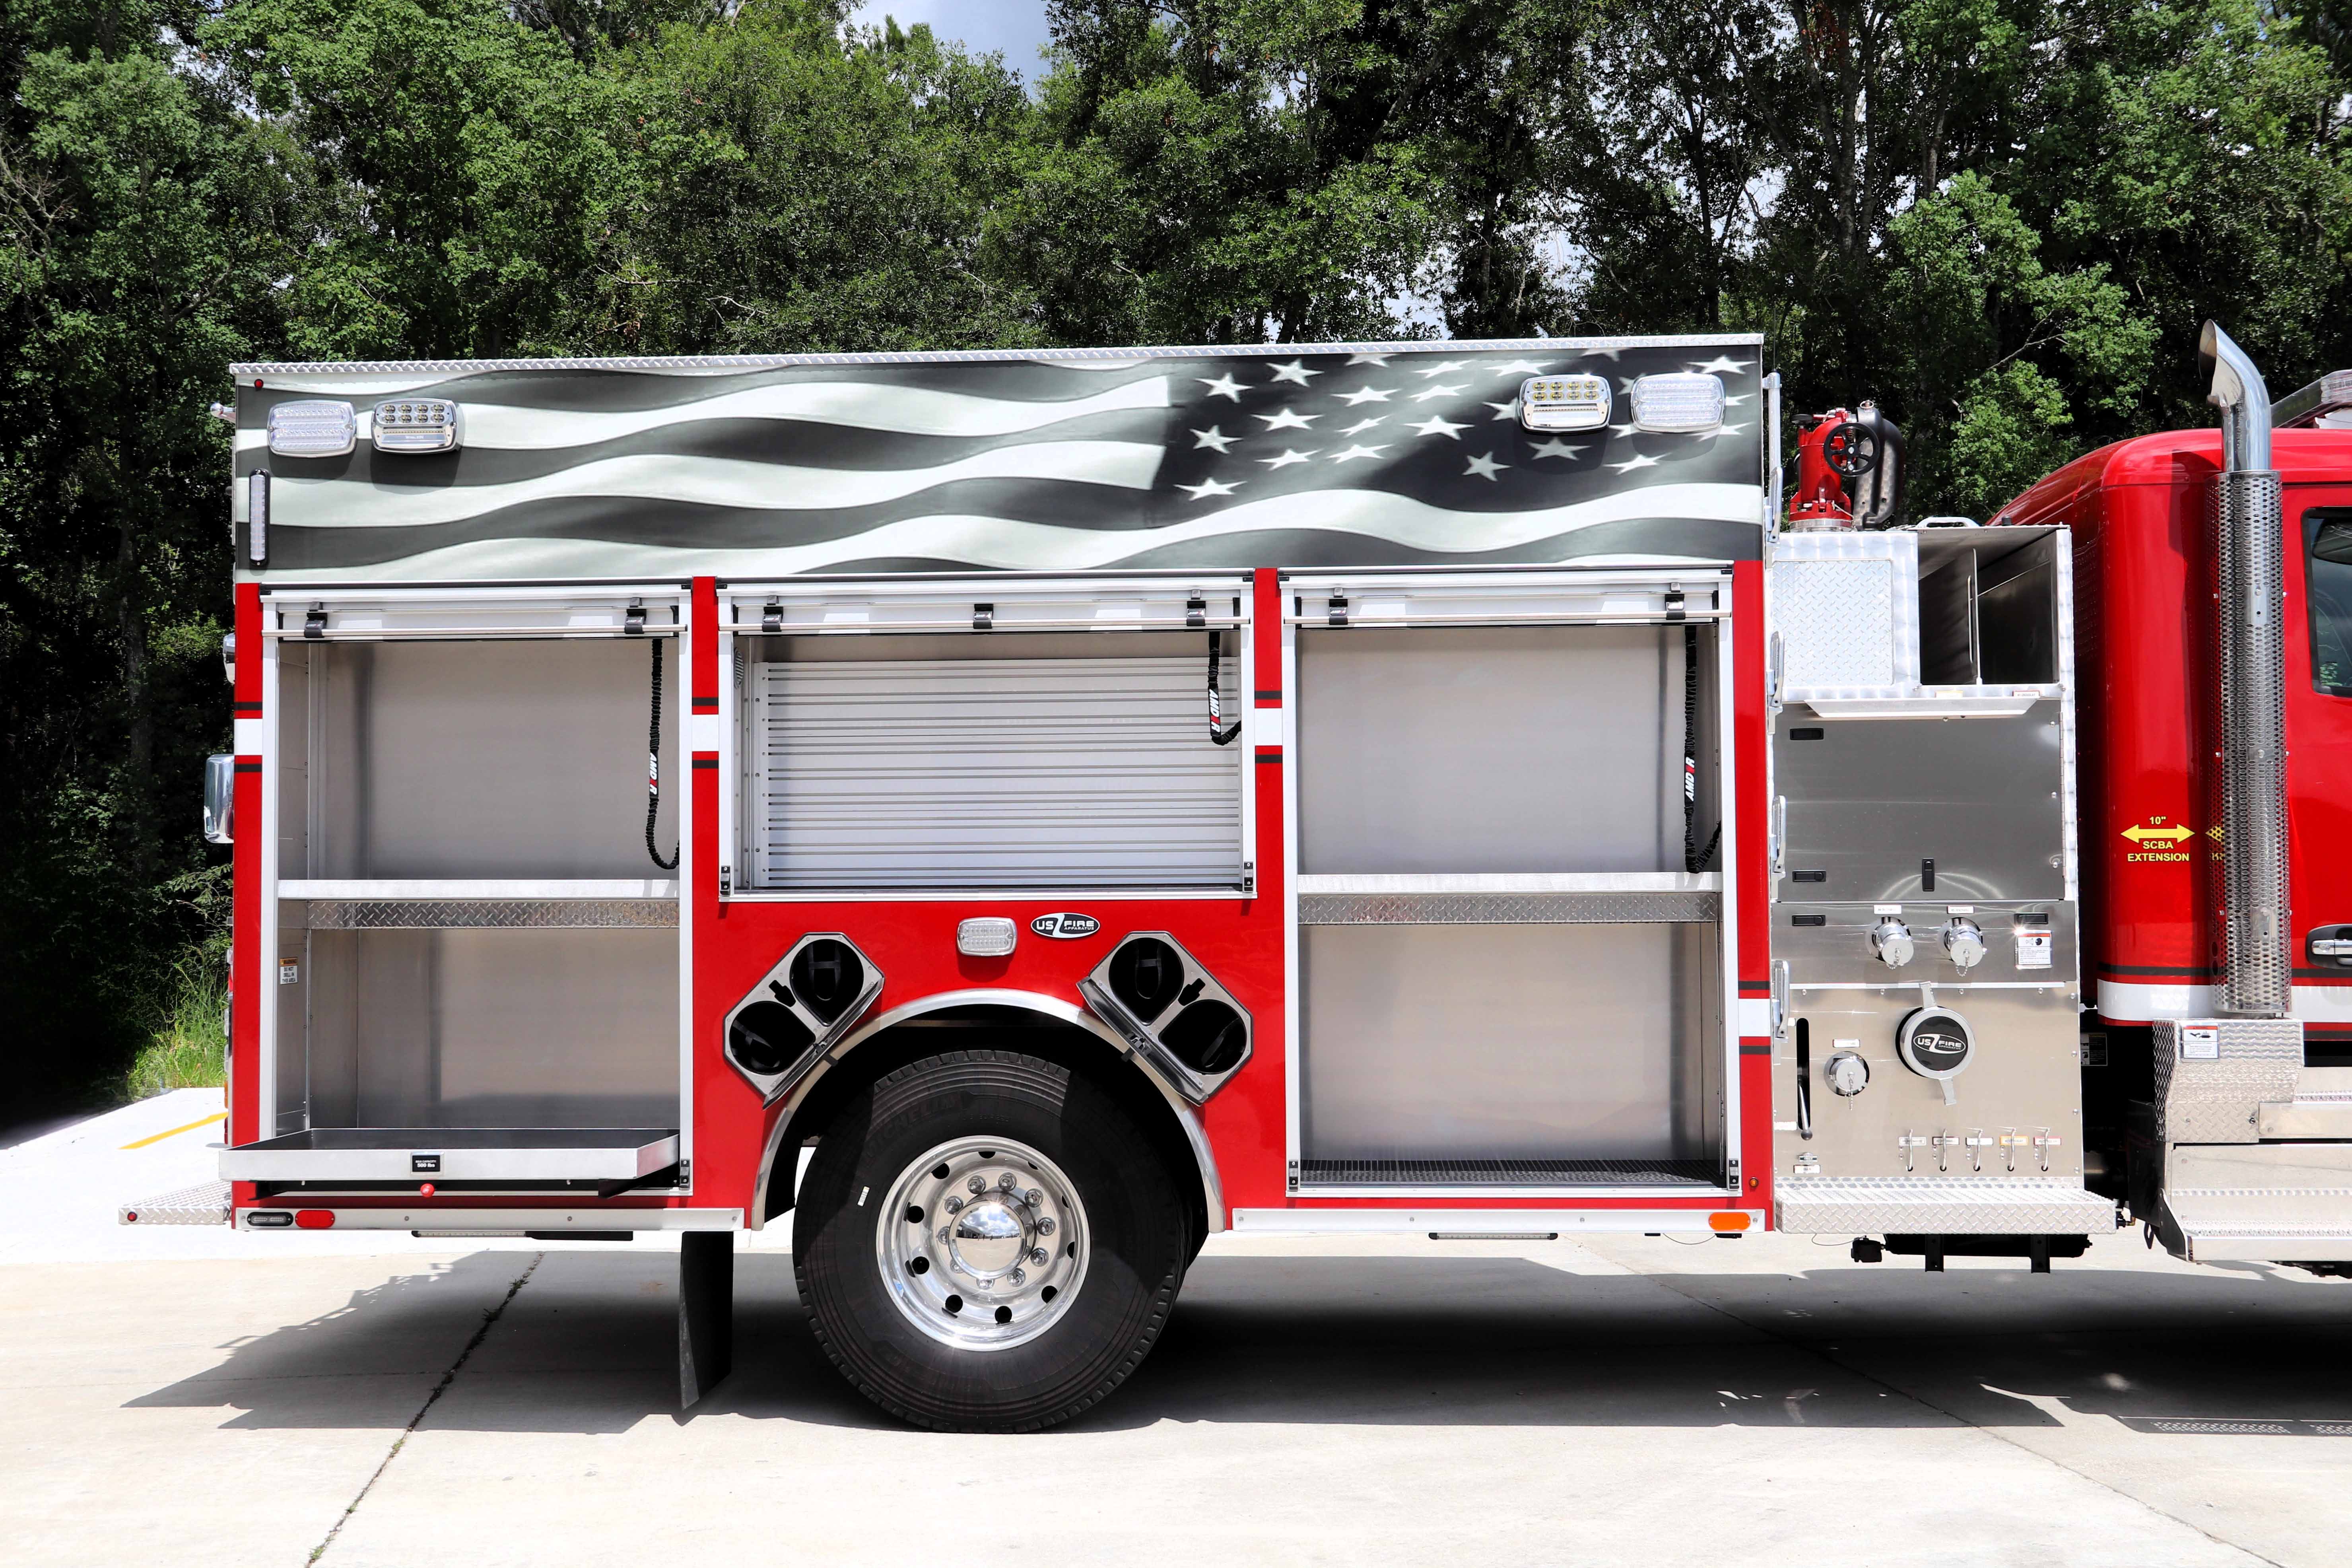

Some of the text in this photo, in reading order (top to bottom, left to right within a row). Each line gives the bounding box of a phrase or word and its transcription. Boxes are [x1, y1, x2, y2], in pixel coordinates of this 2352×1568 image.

[2142, 841, 2174, 849] SCBA
[2127, 853, 2189, 861] EXTENSION
[1036, 921, 1054, 930] US
[1917, 1038, 1931, 1046] US
